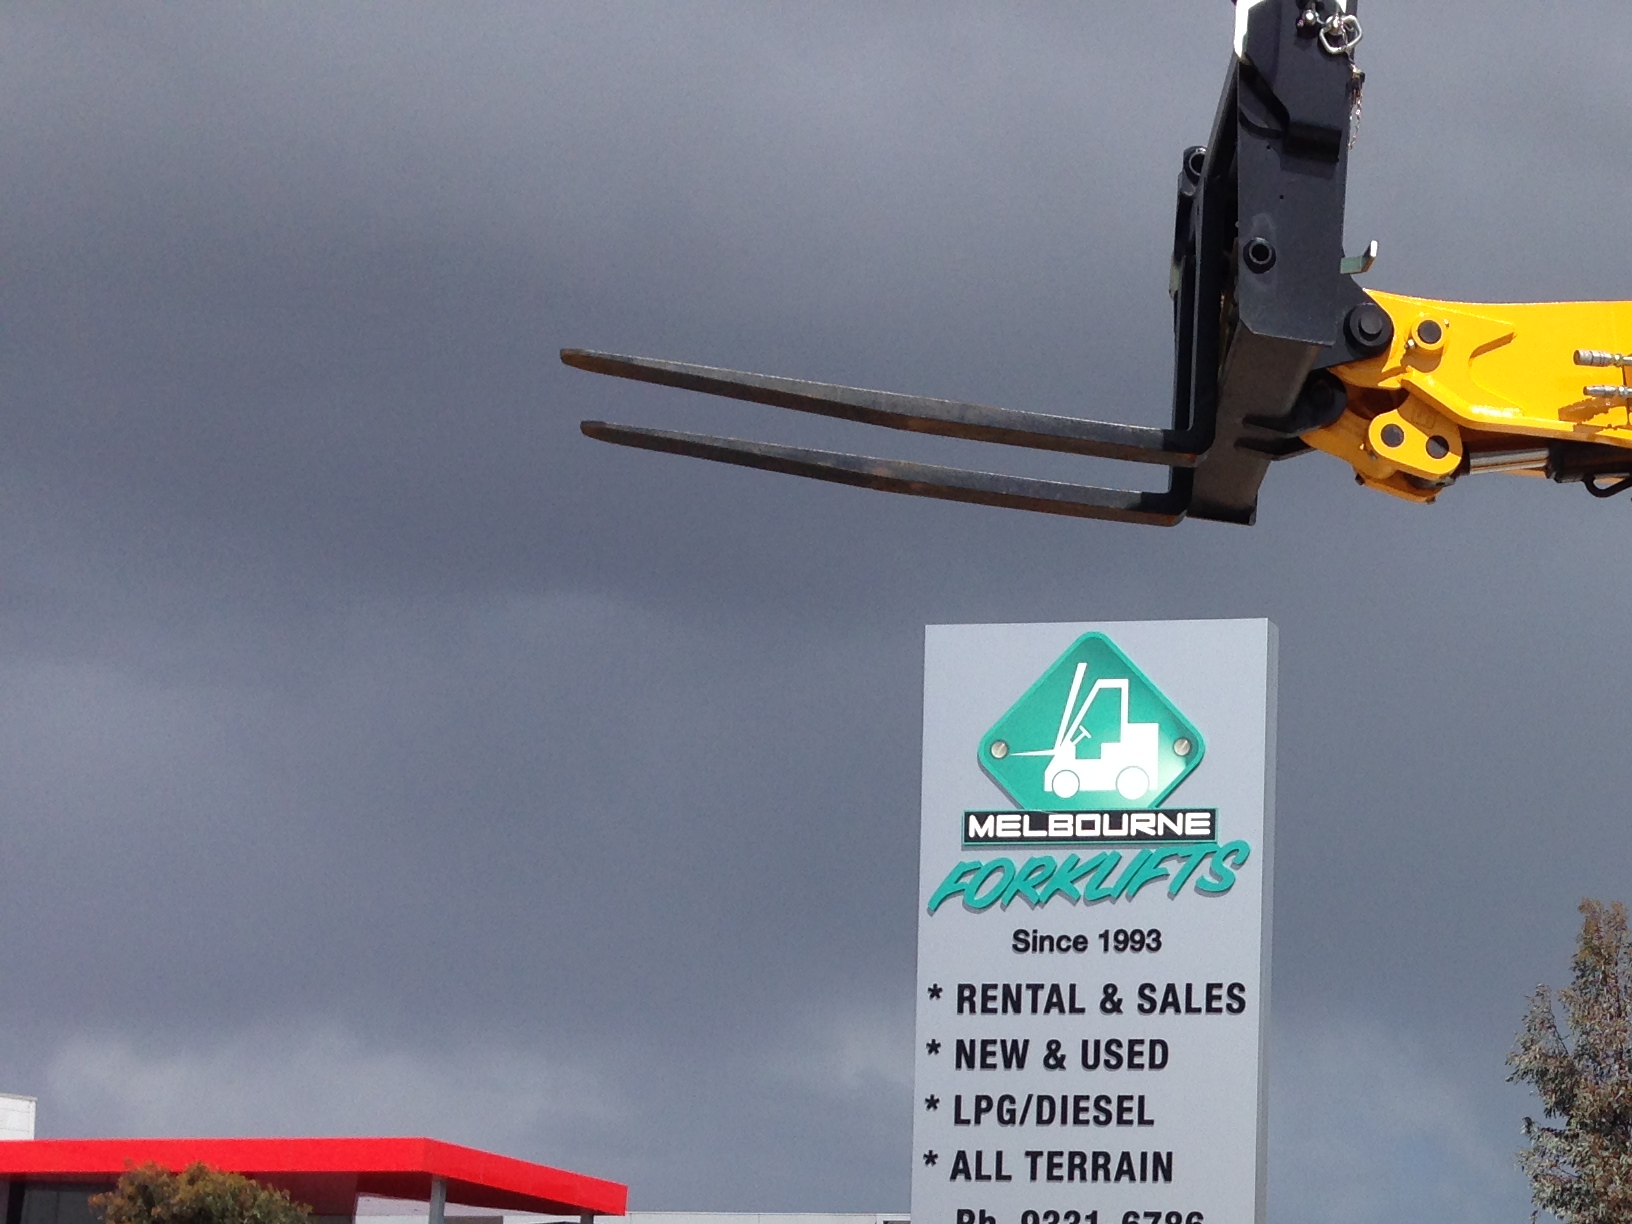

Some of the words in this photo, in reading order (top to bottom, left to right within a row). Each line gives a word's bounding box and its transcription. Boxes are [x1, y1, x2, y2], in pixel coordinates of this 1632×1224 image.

[968, 812, 1212, 839] MELBOURNE
[928, 840, 1251, 912] FORKLIFTS
[1011, 928, 1089, 954] Since
[1098, 928, 1163, 953] 1993
[956, 983, 1086, 1015] RENTAL
[1099, 982, 1123, 1015] &
[1137, 982, 1247, 1015] SALES
[955, 1038, 1030, 1071] NEW
[1042, 1038, 1067, 1071] &
[1081, 1038, 1169, 1071] USED
[953, 1093, 1155, 1127] LPG/DIESEL
[949, 1149, 1013, 1182] ALL
[1024, 1150, 1173, 1183] TERRAIN
